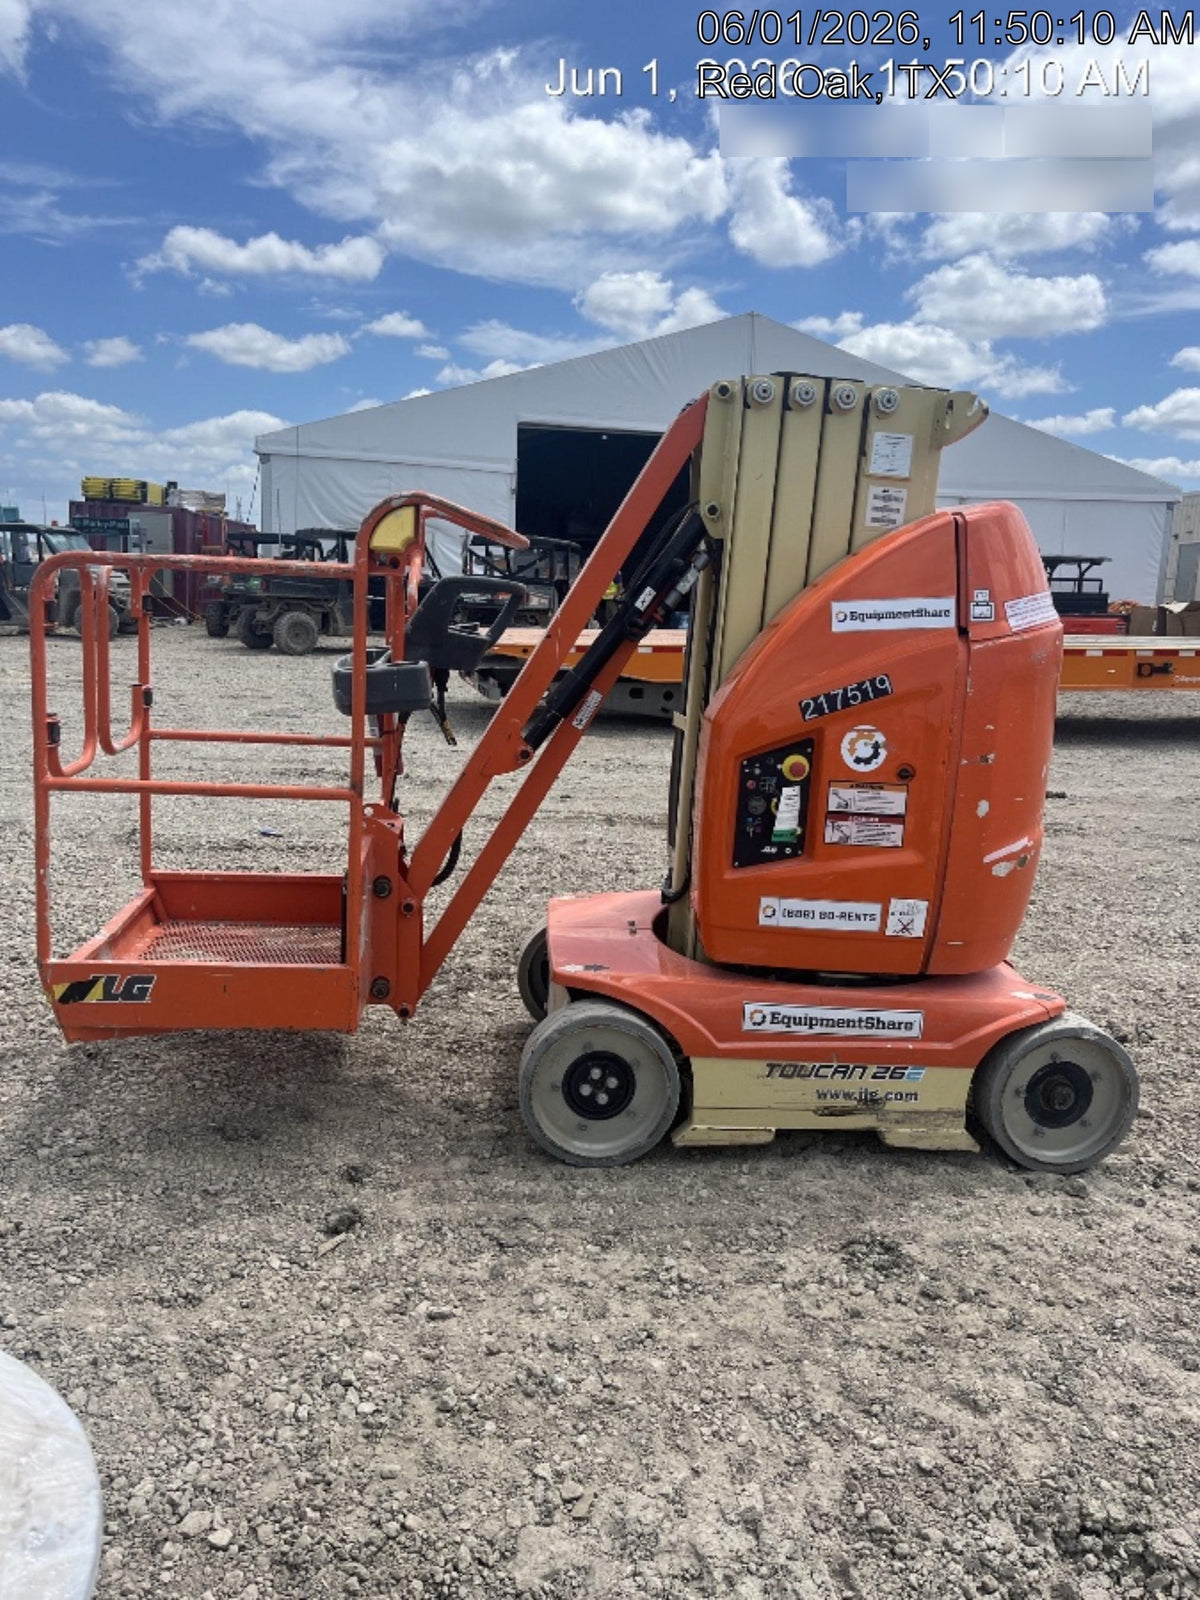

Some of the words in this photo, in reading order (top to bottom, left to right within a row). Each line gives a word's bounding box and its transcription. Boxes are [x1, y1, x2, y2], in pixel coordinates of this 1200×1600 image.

[849, 608, 951, 623] EquipmentShare
[800, 674, 892, 721] 217519
[769, 1011, 916, 1031] EquipmentShare
[765, 1062, 868, 1081] TOUCAN
[816, 1087, 919, 1104] www.jlg.com
